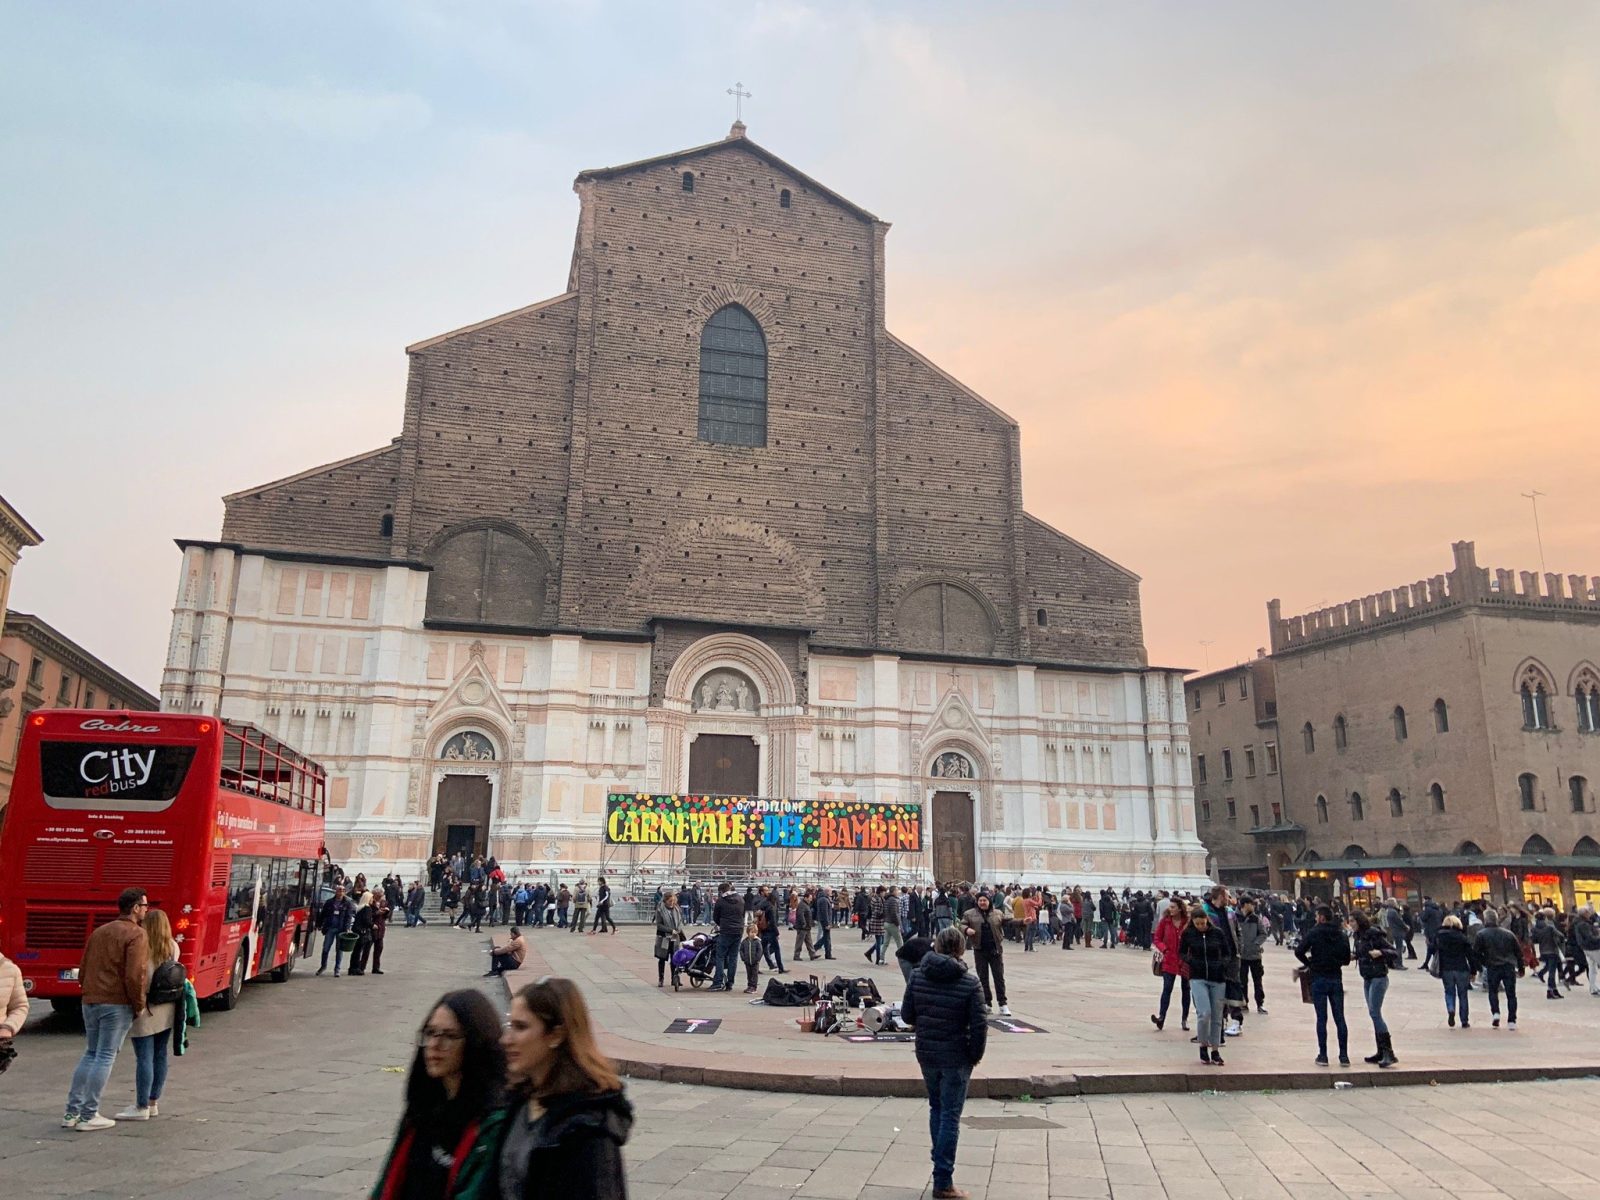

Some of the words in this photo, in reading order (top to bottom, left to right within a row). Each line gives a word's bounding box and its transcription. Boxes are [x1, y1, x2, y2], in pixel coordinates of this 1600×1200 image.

[80, 719, 160, 733] Cobra
[80, 748, 156, 786] City
[756, 800, 805, 813] EDIZIONE
[608, 810, 746, 846] CARNEVALE
[763, 814, 803, 848] DEI
[819, 815, 920, 850] BAMBINI
